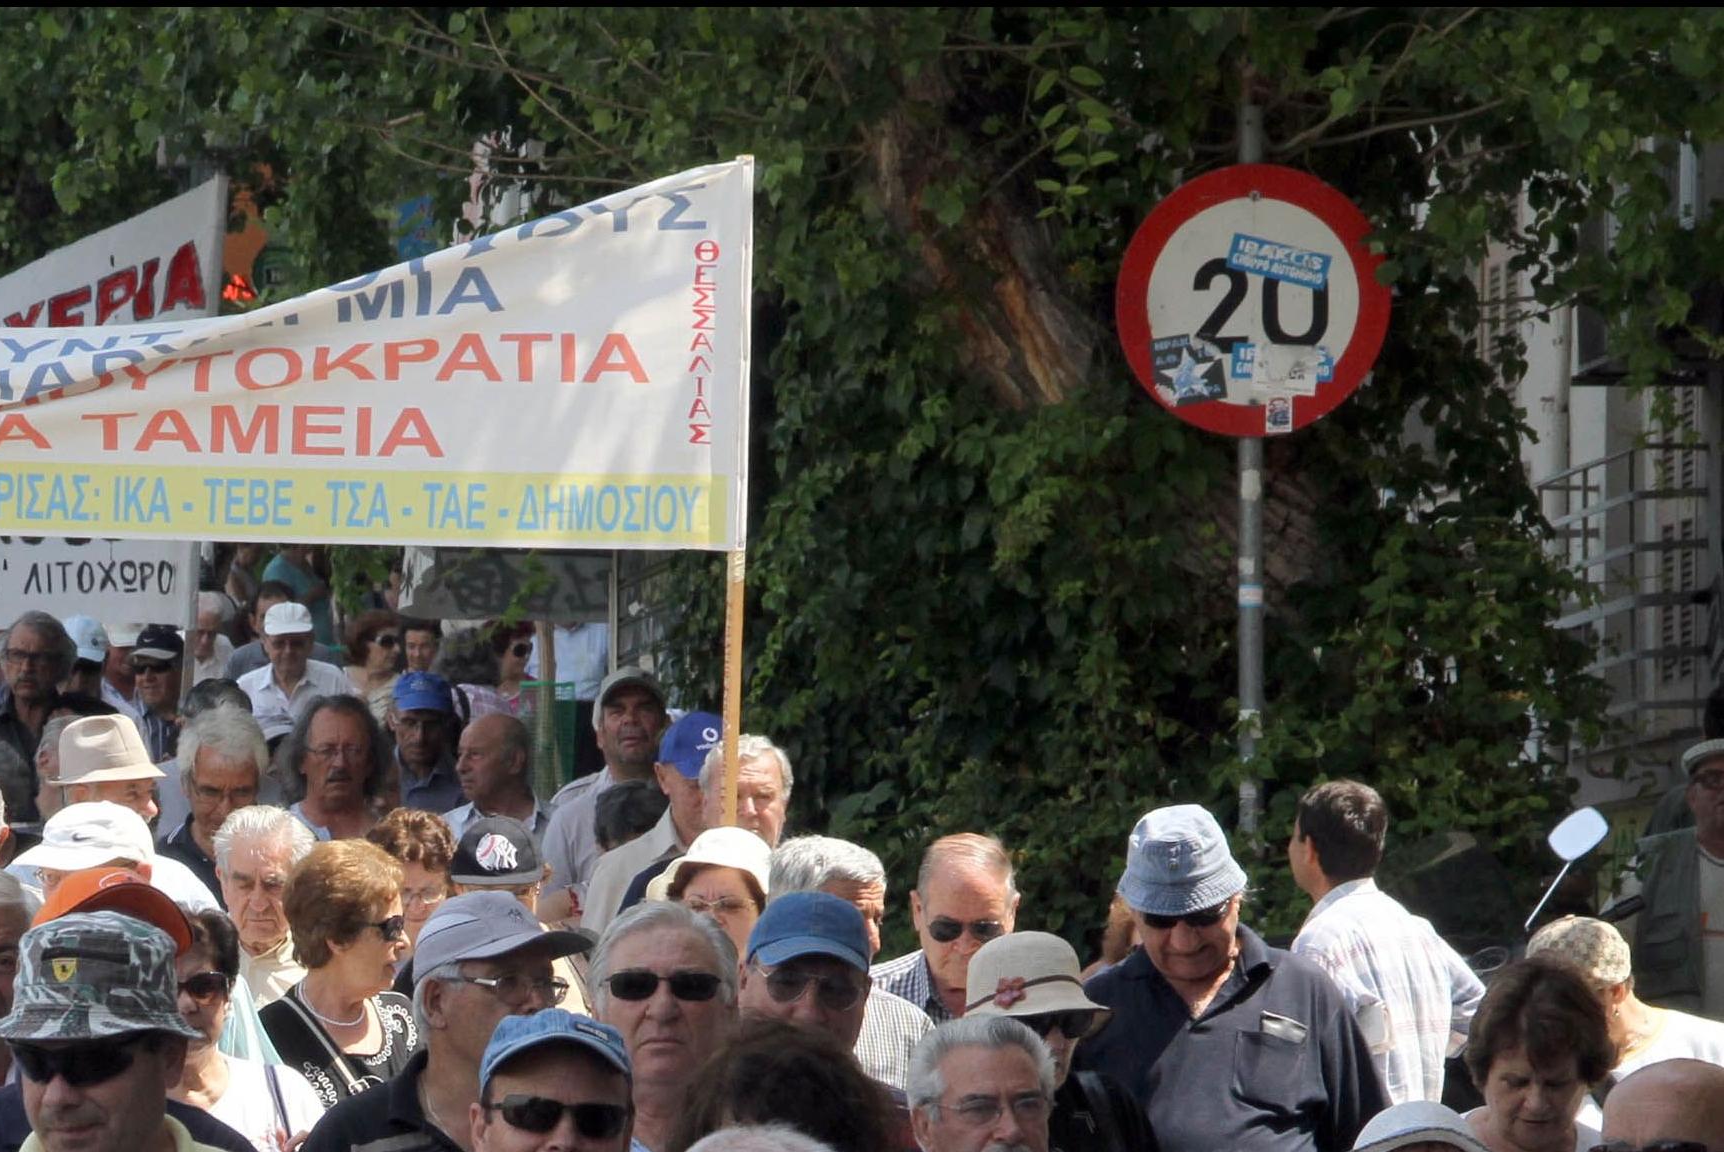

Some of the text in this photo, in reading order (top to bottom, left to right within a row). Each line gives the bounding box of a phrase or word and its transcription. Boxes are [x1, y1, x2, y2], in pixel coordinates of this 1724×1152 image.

[687, 239, 720, 445] ΘΕΣΣΑΛΙΑΣ
[1193, 257, 1330, 355] 20
[81, 404, 444, 457] ΤΑΜΕΙΑ
[114, 476, 171, 523] ΙΚΑ
[204, 478, 293, 526] ΤΕΒΕ
[326, 481, 391, 528] ΤΣΑ
[423, 482, 486, 529] ΤΑΕ
[516, 483, 701, 533] ΔΗΜΟΣΙΟΥ
